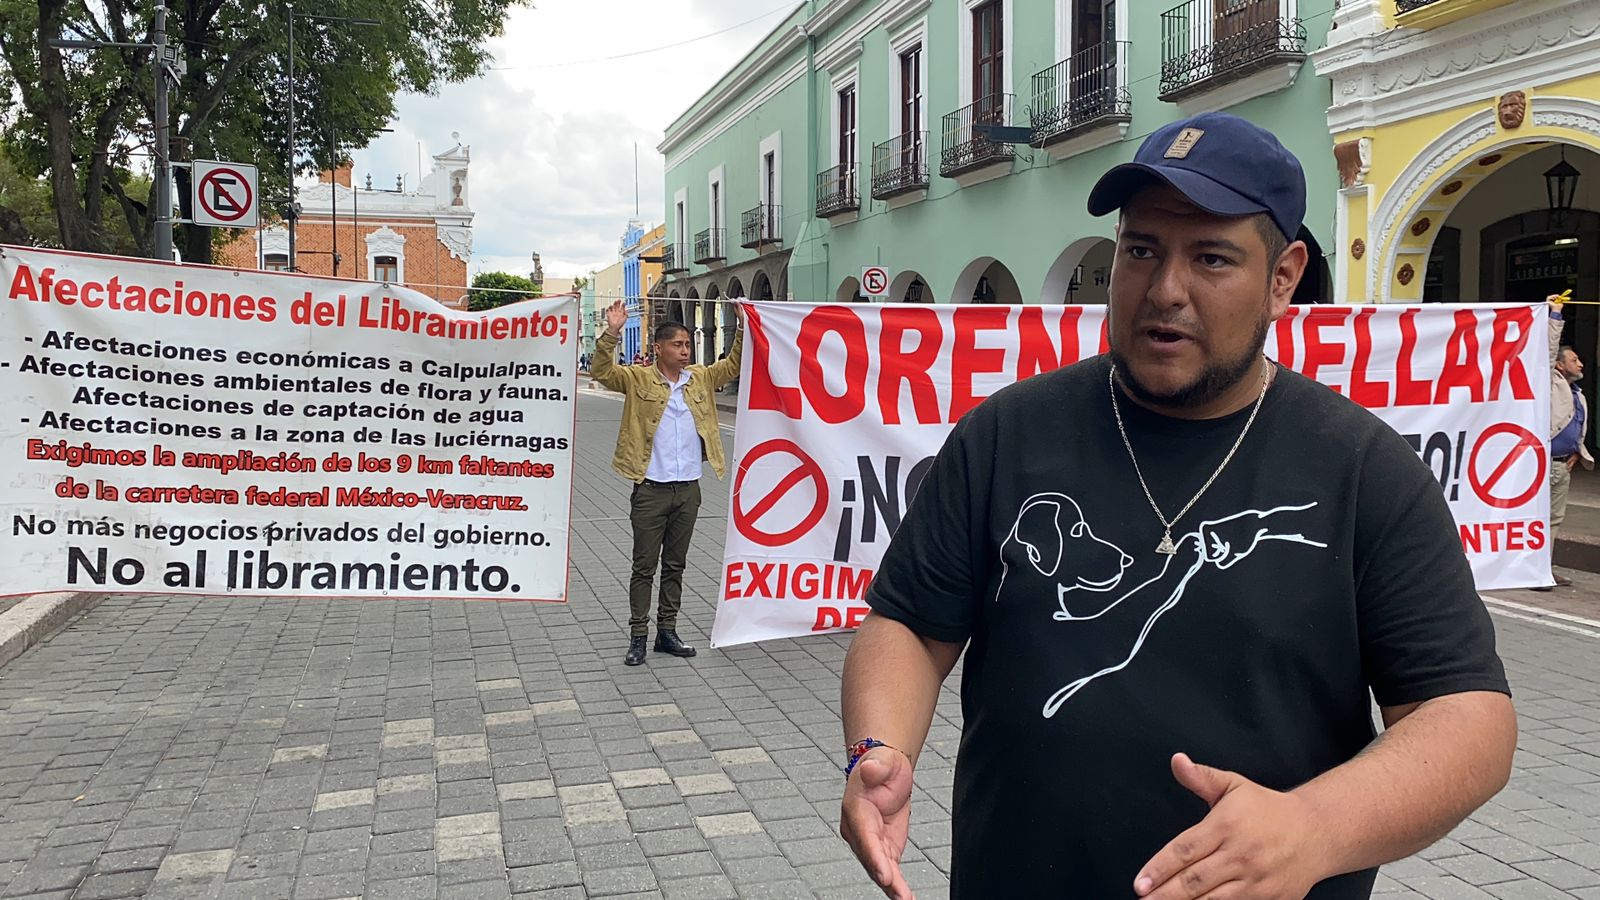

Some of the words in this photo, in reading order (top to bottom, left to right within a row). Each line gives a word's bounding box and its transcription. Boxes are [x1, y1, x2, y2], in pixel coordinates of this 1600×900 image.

[9, 264, 277, 323] Afectaciones
[290, 292, 346, 327] del
[359, 297, 568, 344] Libramiento;
[41, 331, 227, 363] Afectaciones
[236, 351, 390, 370] económicas
[399, 361, 413, 373] a
[421, 361, 562, 382] Calpulalpan.
[742, 303, 1110, 425] LOREN
[19, 355, 205, 387] Afectaciones
[214, 374, 372, 394] ambientales
[380, 379, 410, 396] de
[418, 382, 472, 401] flora
[479, 389, 492, 404] y
[498, 384, 568, 401] fauna.
[72, 386, 253, 415] Afectaciones
[263, 399, 294, 417] de
[302, 402, 425, 421] captación
[433, 409, 461, 424] de
[468, 408, 524, 426] agua
[39, 411, 222, 439] Afectaciones
[231, 428, 246, 440] a
[256, 425, 279, 442] la
[286, 429, 345, 443] zona
[353, 427, 383, 443] de
[392, 428, 426, 447] las
[435, 430, 568, 451] luciérnagas
[27, 439, 146, 467] Exigimos
[153, 445, 176, 467] la
[182, 450, 315, 474] ampliación
[322, 453, 352, 472] de
[358, 453, 391, 472] los
[397, 454, 411, 473] 9
[417, 455, 453, 475] km
[458, 456, 554, 478] faltantes
[55, 477, 89, 500] de
[96, 480, 118, 501] la
[125, 484, 239, 505] carretera
[245, 486, 329, 507] federal
[336, 487, 528, 511] México-Veracruz.
[13, 515, 56, 536] No
[67, 516, 124, 537] más
[135, 520, 258, 545] negocios
[267, 522, 378, 545] privados
[387, 523, 425, 544] del
[433, 524, 551, 548] gobierno.
[67, 547, 145, 585] No
[163, 550, 207, 588] al
[228, 551, 520, 593] libramiento.
[725, 562, 873, 600] EXIGIM
